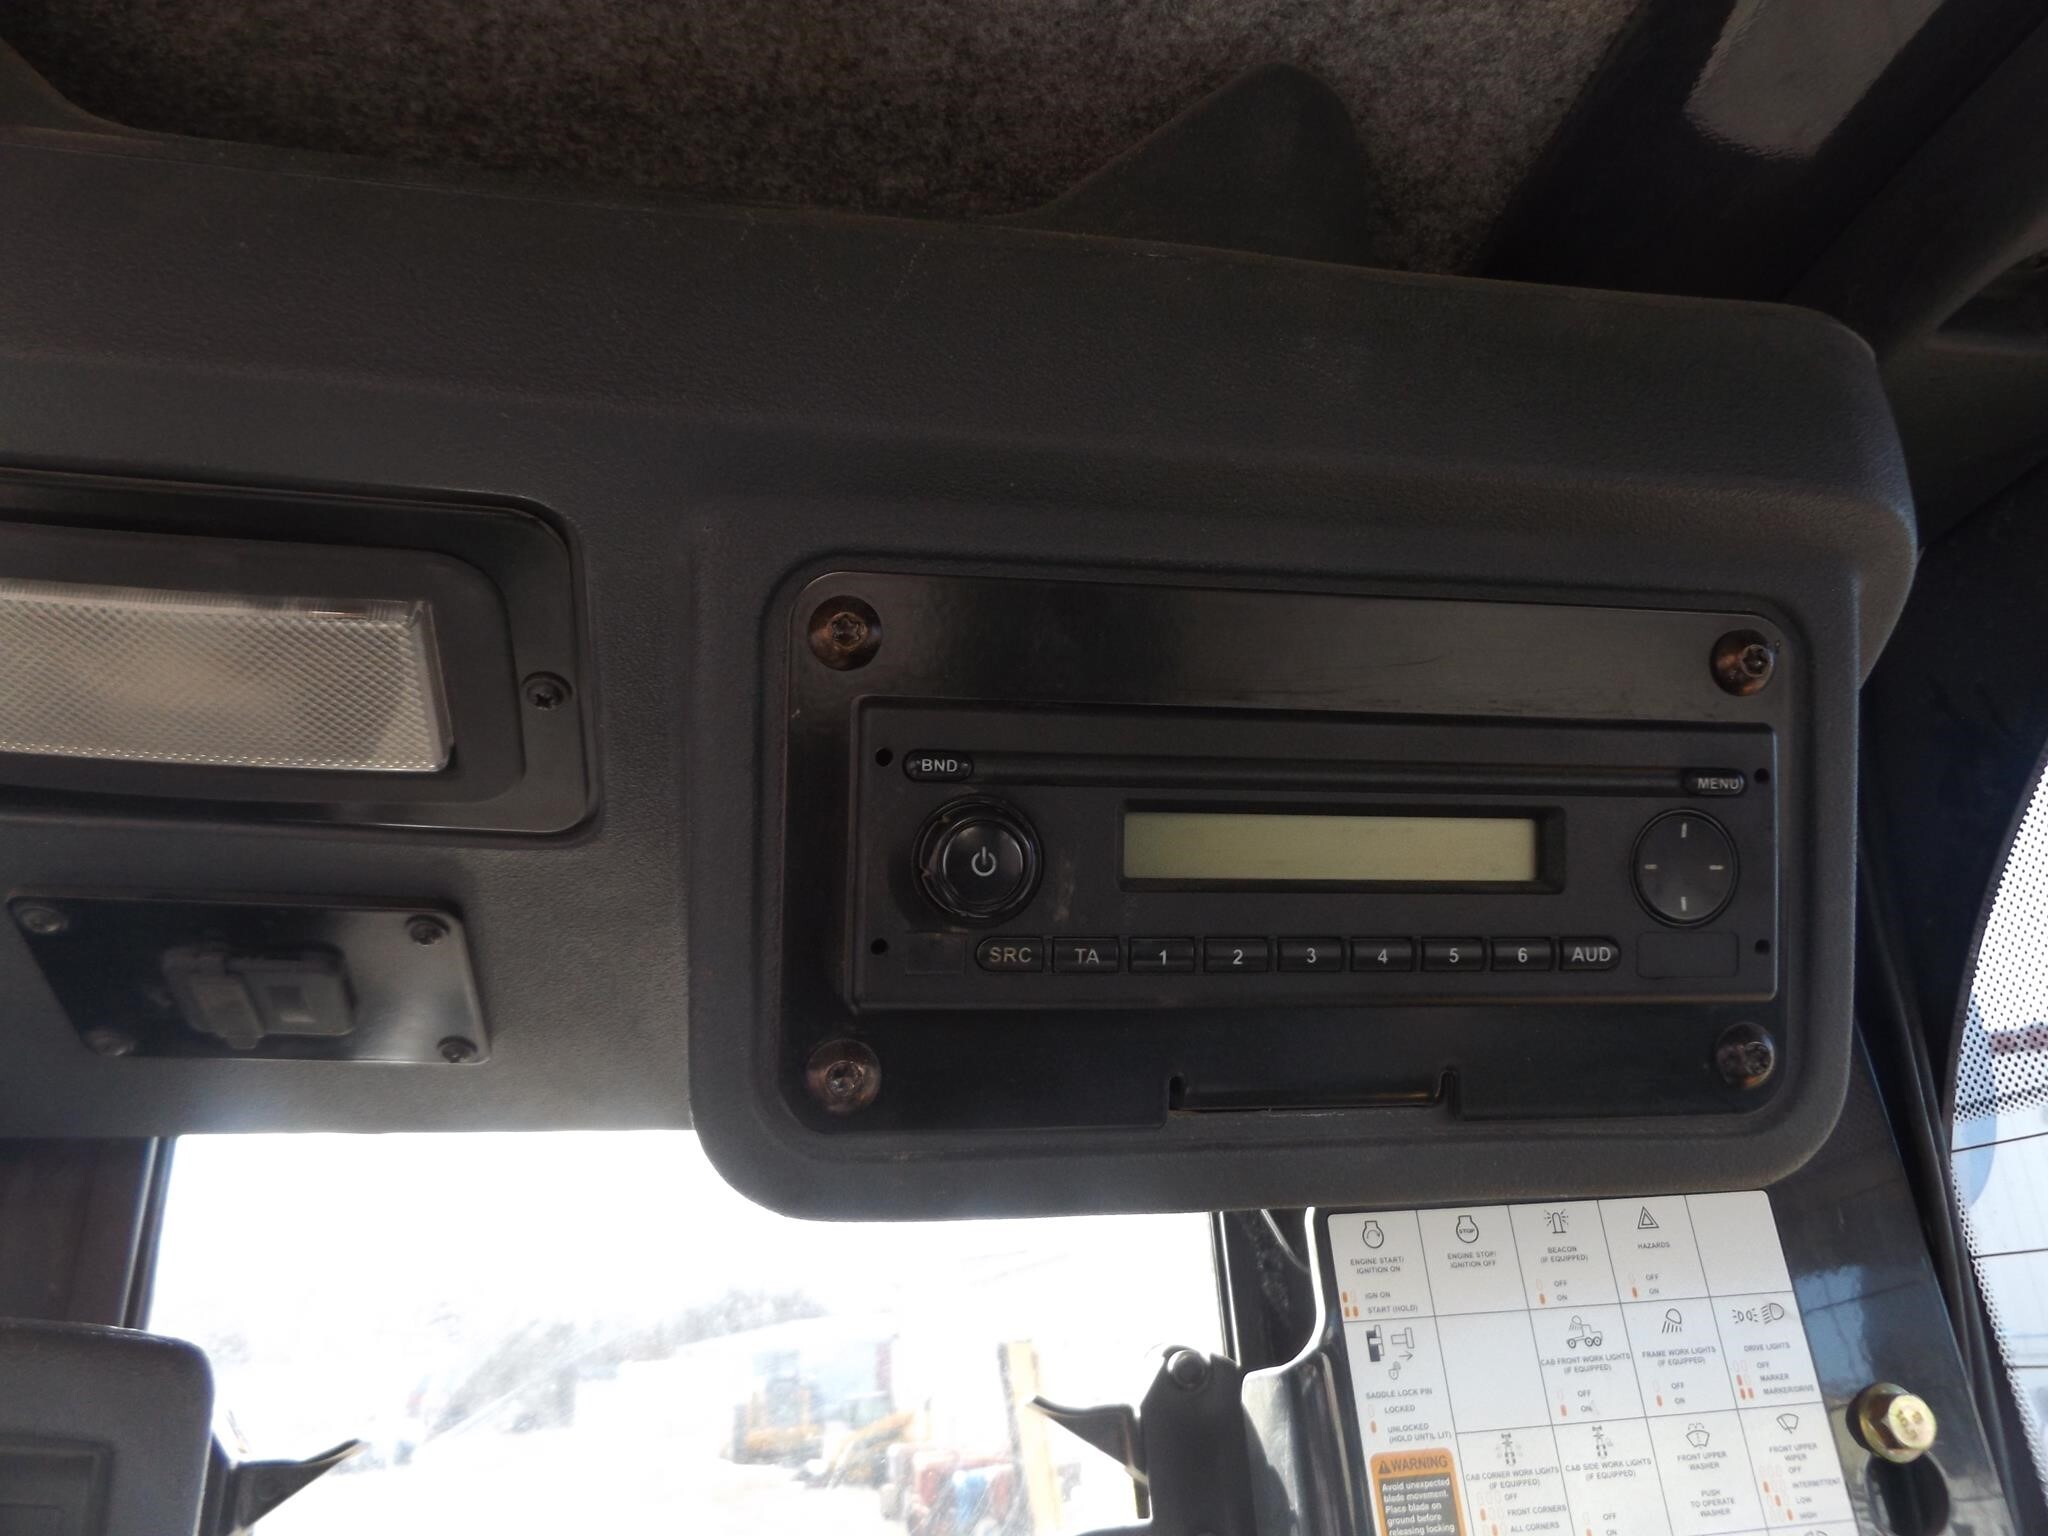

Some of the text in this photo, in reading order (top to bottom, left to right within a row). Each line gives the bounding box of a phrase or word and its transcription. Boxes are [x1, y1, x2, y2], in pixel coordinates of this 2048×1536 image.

[921, 759, 958, 772] BND
[1697, 777, 1740, 790] MENU
[989, 947, 1032, 963] SRC
[1075, 948, 1100, 964] TA
[1159, 949, 1167, 965] 1
[1233, 949, 1243, 965] 2
[1306, 947, 1317, 963] 3
[1377, 948, 1389, 964] 4
[1449, 948, 1459, 963] 5
[1517, 947, 1528, 963] 6
[1571, 947, 1612, 963] AUD
[1547, 1246, 1577, 1254] BEACON
[1637, 1241, 1671, 1250] HAZARDS
[1350, 1257, 1377, 1266] ENGINE
[1447, 1252, 1473, 1260] ENGINE
[1550, 1254, 1589, 1263] EQUIPPED)
[1356, 1265, 1401, 1274] IGNITION ON
[1450, 1261, 1481, 1269] IGNITION
[1645, 1273, 1659, 1281] OFF
[1554, 1279, 1568, 1288] OFF
[1379, 1291, 1391, 1299] ON
[1649, 1287, 1660, 1296] ON
[1556, 1294, 1568, 1302] ON
[1367, 1304, 1418, 1314] START (HOLD)
[1641, 1346, 1716, 1358] FRAME WORK LIGHTS
[1743, 1341, 1791, 1352] DRIVE LIGHTS
[1557, 1356, 1580, 1364] FRONT
[1605, 1352, 1631, 1361] LIGHTS
[1667, 1356, 1706, 1366] EQUIPPED)
[1573, 1363, 1612, 1373] EQUIPPED)
[1756, 1361, 1769, 1369] OFF
[1760, 1373, 1790, 1382] MARKER
[1671, 1381, 1684, 1390] OFF
[1365, 1387, 1433, 1400] SADDLE LOCK PIN
[1577, 1389, 1591, 1397] OFF
[1674, 1397, 1686, 1405] ON
[1384, 1404, 1416, 1414] LOCKED
[1580, 1405, 1593, 1413] ON
[1387, 1422, 1430, 1433] UNLOCKED
[1388, 1430, 1452, 1444] (HOLD UNTIL LIT)
[1768, 1442, 1818, 1453] FRONT UPPER
[1676, 1450, 1728, 1461] FRONT UPPER
[1783, 1453, 1807, 1461] WIPER
[1390, 1455, 1448, 1473] WARNING
[1565, 1457, 1652, 1472] CAB SIDE WORK LIGHTS
[1689, 1461, 1720, 1471] WASHER
[1465, 1466, 1560, 1481] CAB CORNER WORK LIGHTS
[1596, 1469, 1636, 1480] EQUIPPED)
[1788, 1466, 1802, 1474] OFF
[1382, 1477, 1450, 1491] Avoid unexpected
[1499, 1478, 1541, 1489] EQUIPPED)
[1792, 1477, 1841, 1488] INTERMITTENT
[1383, 1490, 1449, 1503] blade movement.
[1504, 1492, 1518, 1501] OFF
[1701, 1489, 1721, 1497] PUSH
[1690, 1497, 1735, 1508] TO OPERATE
[1796, 1496, 1812, 1505] LOW
[1385, 1502, 1442, 1514] Place blade on
[1507, 1504, 1567, 1516] FRONT CORNERS
[1700, 1508, 1731, 1518] WASHER
[1387, 1513, 1442, 1528] ground before
[1602, 1512, 1617, 1521] OFF
[1389, 1523, 1456, 1536] releasing locking
[1510, 1521, 1560, 1533] ALL CORNERS
